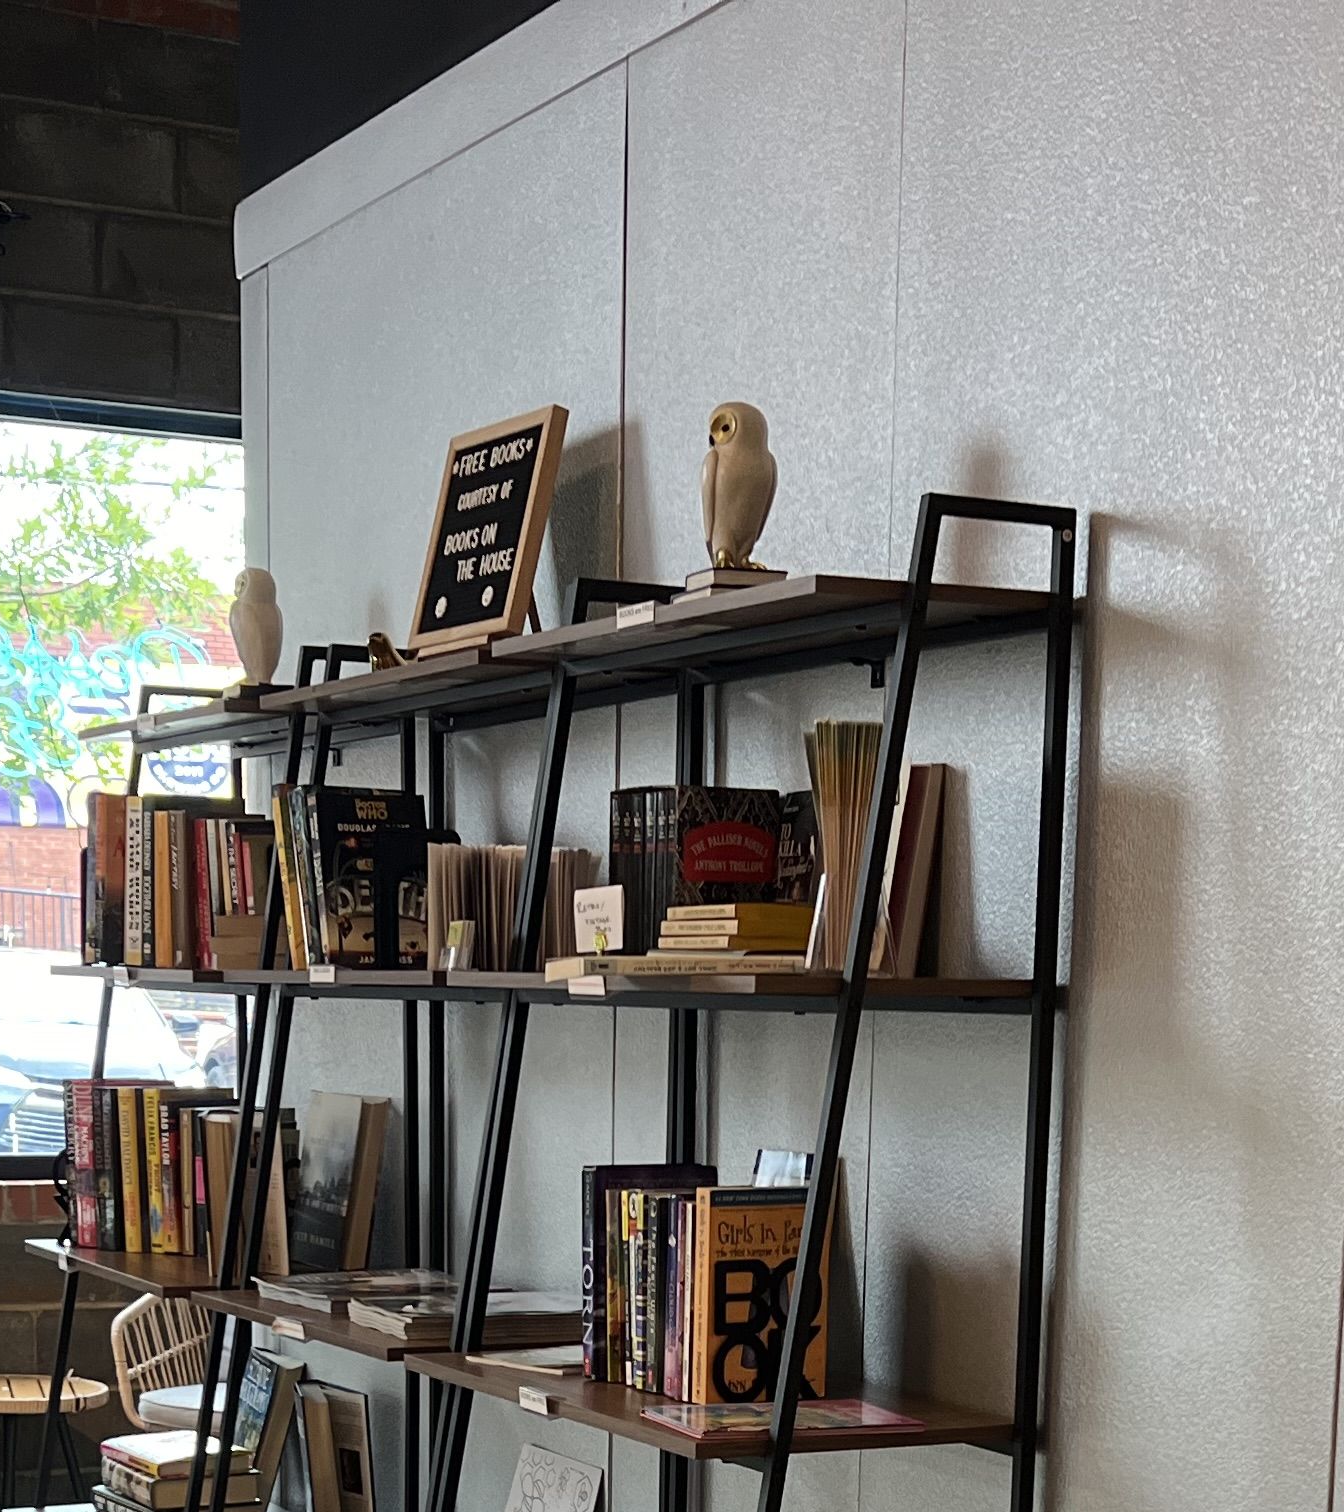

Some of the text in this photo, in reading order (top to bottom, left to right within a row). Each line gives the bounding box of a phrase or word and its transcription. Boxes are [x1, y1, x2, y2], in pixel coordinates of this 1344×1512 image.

[459, 442, 526, 478] FREE BOOKS
[457, 479, 514, 511] COURTESY OF
[444, 522, 498, 556] BOOKS ON
[457, 548, 513, 583] THE HOUSE
[355, 807, 389, 820] WHO
[147, 1095, 158, 1156] FELIX FRANCIS
[159, 1104, 171, 1166] BRAD TAYLOR
[582, 1239, 594, 1345] TORN
